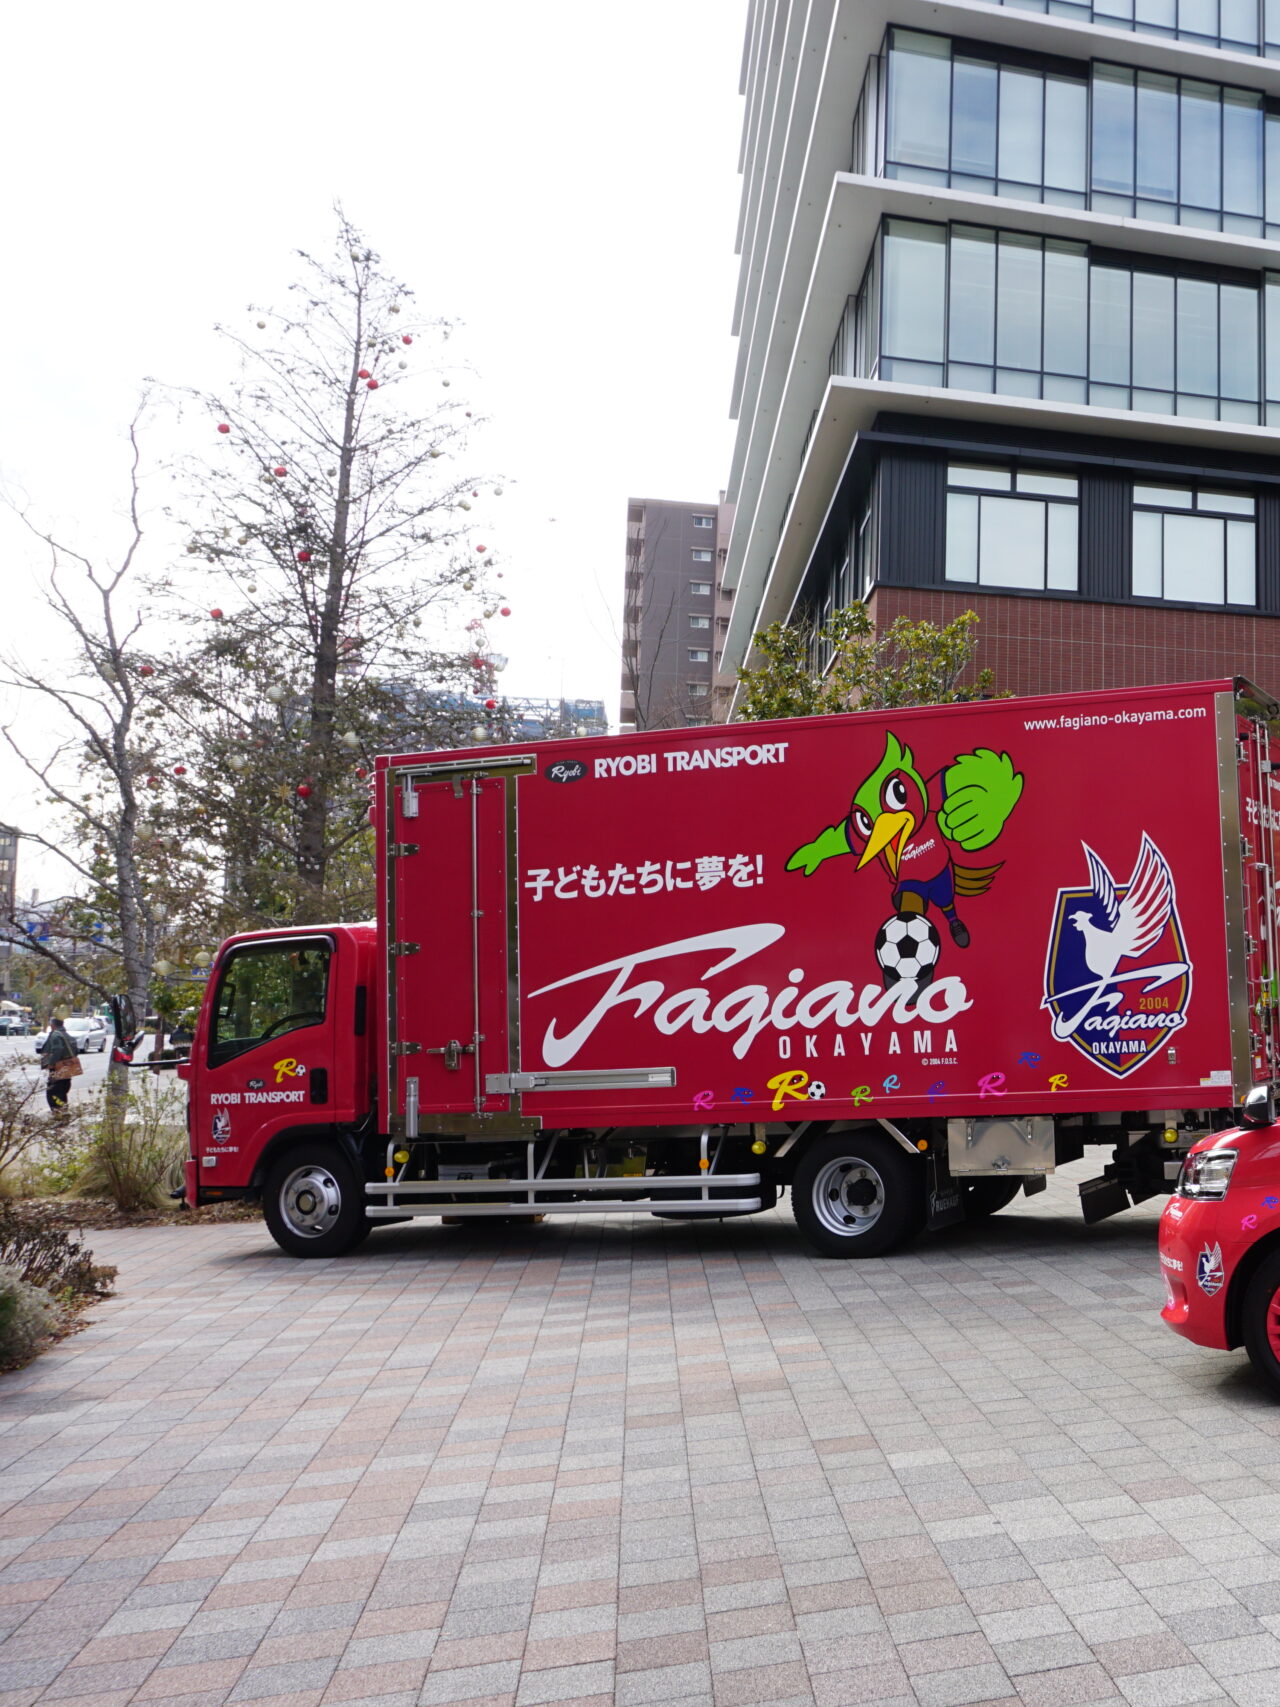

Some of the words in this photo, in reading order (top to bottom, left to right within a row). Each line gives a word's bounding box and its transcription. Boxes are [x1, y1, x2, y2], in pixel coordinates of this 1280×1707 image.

[1023, 705, 1206, 731] www.fagiano-okayama.com
[551, 764, 582, 782] Ryobi
[594, 753, 657, 778] RYOBI
[663, 742, 789, 772] TRANSPORT
[524, 854, 764, 903] 子どもたちに夢を!
[527, 923, 975, 1068] Fagiano
[1046, 962, 1190, 1039] Fagiano
[1139, 997, 1169, 1010] 2004
[778, 1029, 958, 1060] OKAYAMA
[1091, 1040, 1148, 1055] OKAYAMA
[210, 1093, 241, 1105] RYOBI
[243, 1090, 305, 1104] TRANSPORT
